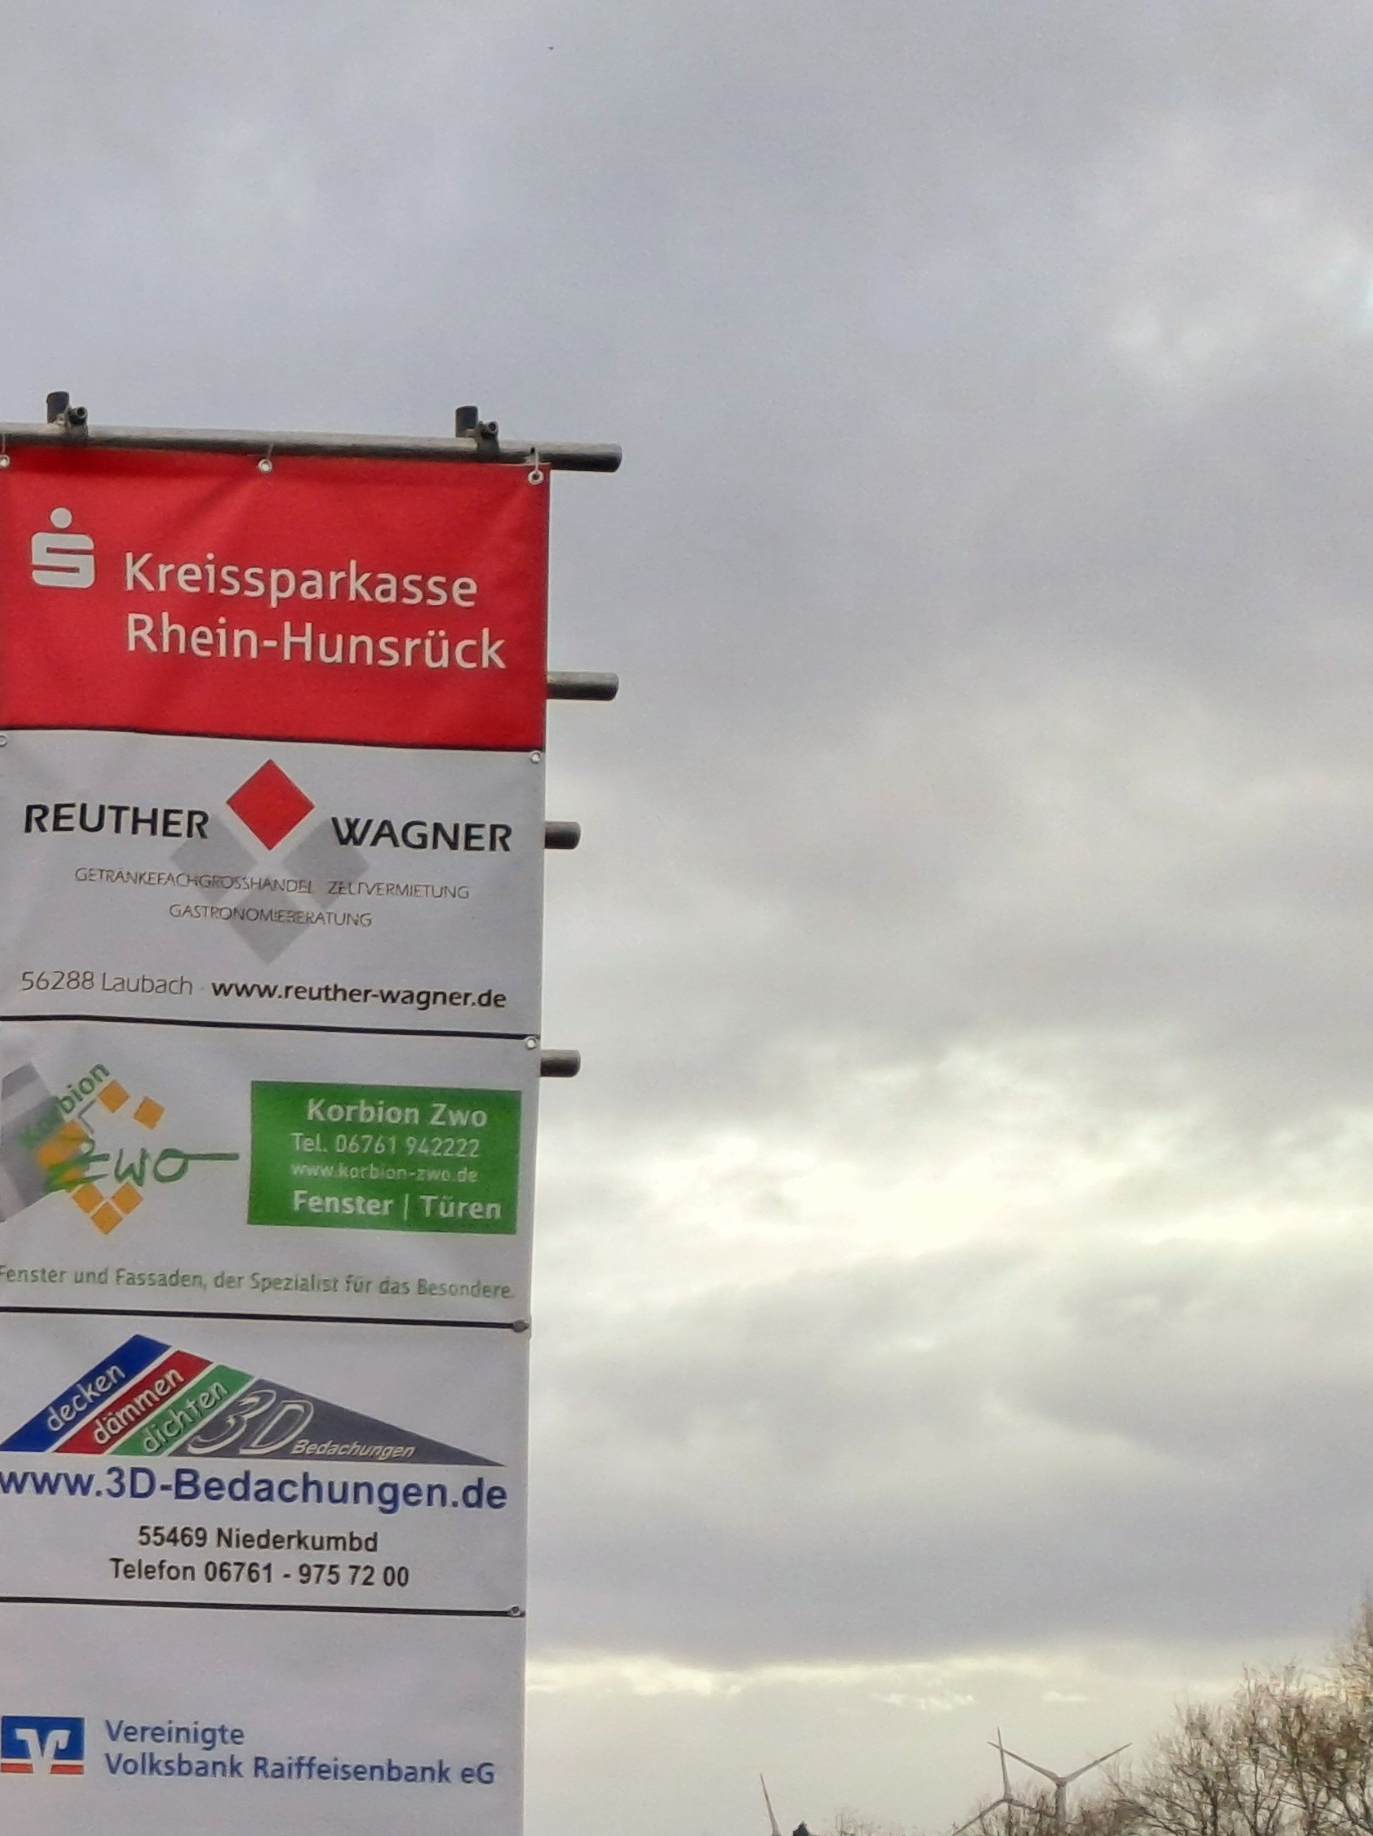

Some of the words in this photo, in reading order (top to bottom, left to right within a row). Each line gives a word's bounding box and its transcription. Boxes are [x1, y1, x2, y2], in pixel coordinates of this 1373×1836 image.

[125, 552, 479, 608] Kreissparkasse
[126, 612, 507, 670] Rhein-Hunsrück
[23, 802, 209, 839] REUTHER
[331, 816, 513, 853] WAGNER
[169, 903, 374, 927] GASTRONOMIEBERATUNG
[21, 971, 95, 992] 56288
[101, 972, 193, 996] Laubach
[211, 979, 507, 1011] www.reuther-wagner.de
[308, 1099, 419, 1125] Korbion
[430, 1103, 488, 1127] Zwo
[291, 1133, 327, 1152] Tel.
[336, 1134, 396, 1154] 06761
[407, 1137, 480, 1158] 942222
[292, 1162, 478, 1183] www.korbion-zwo.de
[293, 1190, 393, 1215] Fenster
[420, 1195, 502, 1219] Türen
[75, 1268, 108, 1284] und
[116, 1268, 206, 1290] Fassaden,
[214, 1271, 244, 1289] der
[251, 1272, 339, 1293] Spezialist
[346, 1275, 372, 1293] für
[379, 1276, 410, 1294] das
[46, 1364, 126, 1432] decken
[93, 1368, 184, 1445] dämmen
[143, 1381, 228, 1453] dichten
[187, 1388, 314, 1456] 3D
[291, 1438, 416, 1460] Bedachungen
[138, 1527, 207, 1549] 55469
[215, 1528, 379, 1553] Niederkumbd
[110, 1557, 196, 1582] Telefon
[204, 1560, 273, 1583] 06761
[299, 1563, 341, 1585] 975
[348, 1565, 376, 1586] 72
[383, 1566, 409, 1587] 00
[105, 1719, 245, 1750] Vereinigte
[105, 1753, 243, 1778] Volksbank
[254, 1755, 451, 1784] Raiffeisenbank
[461, 1762, 495, 1784] eG
